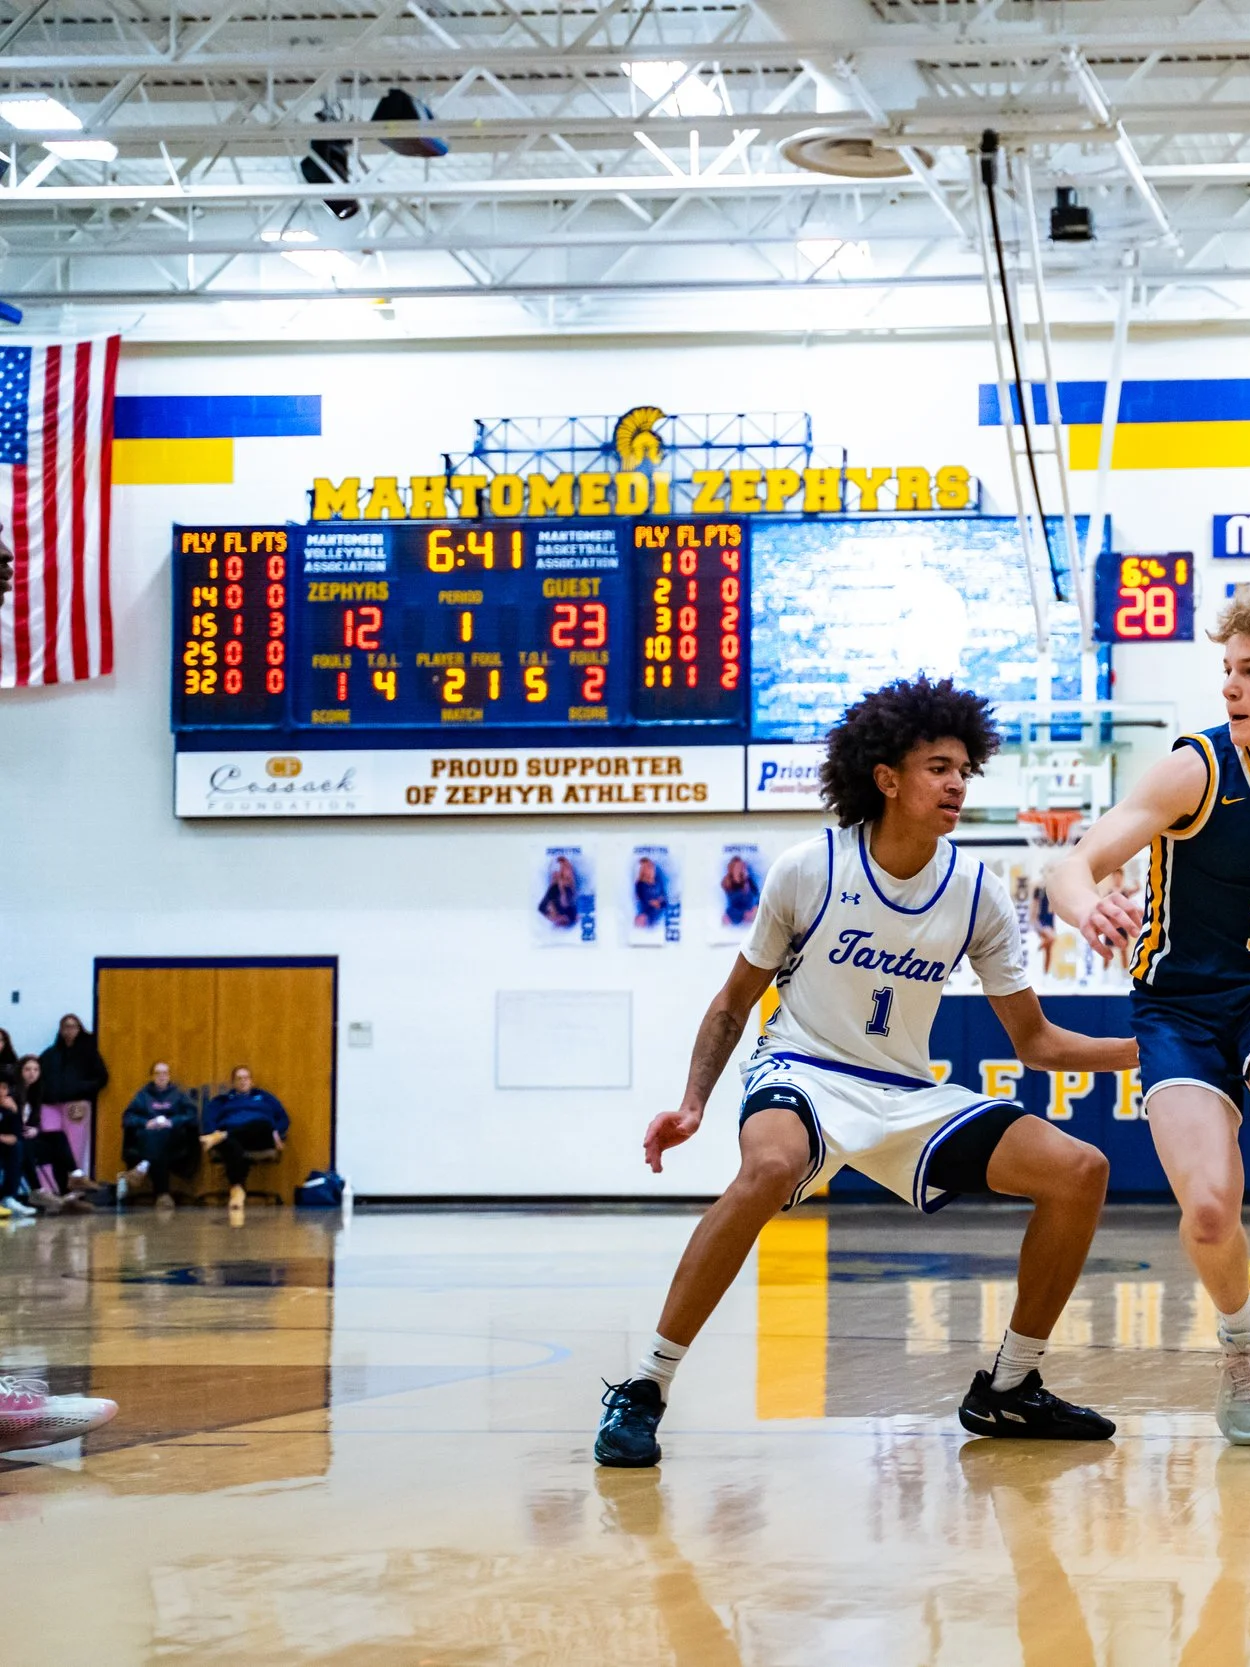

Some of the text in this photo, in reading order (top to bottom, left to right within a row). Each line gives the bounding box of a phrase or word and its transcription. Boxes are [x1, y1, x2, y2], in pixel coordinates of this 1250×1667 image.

[312, 465, 974, 521] MAHTOMEDI ZEPHYRS
[182, 532, 288, 553] PLY FL PTS
[536, 543, 618, 556] BASKETBALL
[635, 524, 742, 547] PLY FL PTS
[304, 547, 387, 560] VOLLEYBALL
[426, 529, 523, 573] 6:41
[536, 557, 619, 570] ASSOCIATION
[662, 549, 739, 576] 1 0 4
[209, 555, 286, 581] 1 0 0
[304, 561, 387, 574] ASSOCIATION
[192, 583, 286, 609] 14 0 0
[308, 581, 389, 602] ZEPHYRS
[542, 577, 602, 598] GUEST
[653, 576, 740, 604] 2 1 0
[192, 611, 285, 638] 15 1 3
[552, 602, 607, 648] 23
[655, 605, 740, 633] 3 0 2
[1116, 586, 1175, 636] 28
[343, 606, 383, 650] 12
[461, 611, 473, 642] 1
[183, 639, 285, 666] 25 0 0
[416, 652, 465, 667] PLAYER
[644, 633, 740, 661] 10 0 0
[185, 668, 285, 694] 32 0 0
[337, 671, 348, 701] 1
[373, 671, 396, 701] 4
[443, 667, 500, 703] 2 1
[524, 666, 548, 703] 5
[581, 665, 607, 702] 2
[644, 662, 740, 690] 11 1 2
[431, 755, 682, 779] PROUD SUPPORTER
[757, 761, 823, 791] Priori
[406, 781, 708, 806] OF ZEPHYR ATHLETICS
[829, 929, 947, 983] Tartan
[865, 986, 893, 1037] 1
